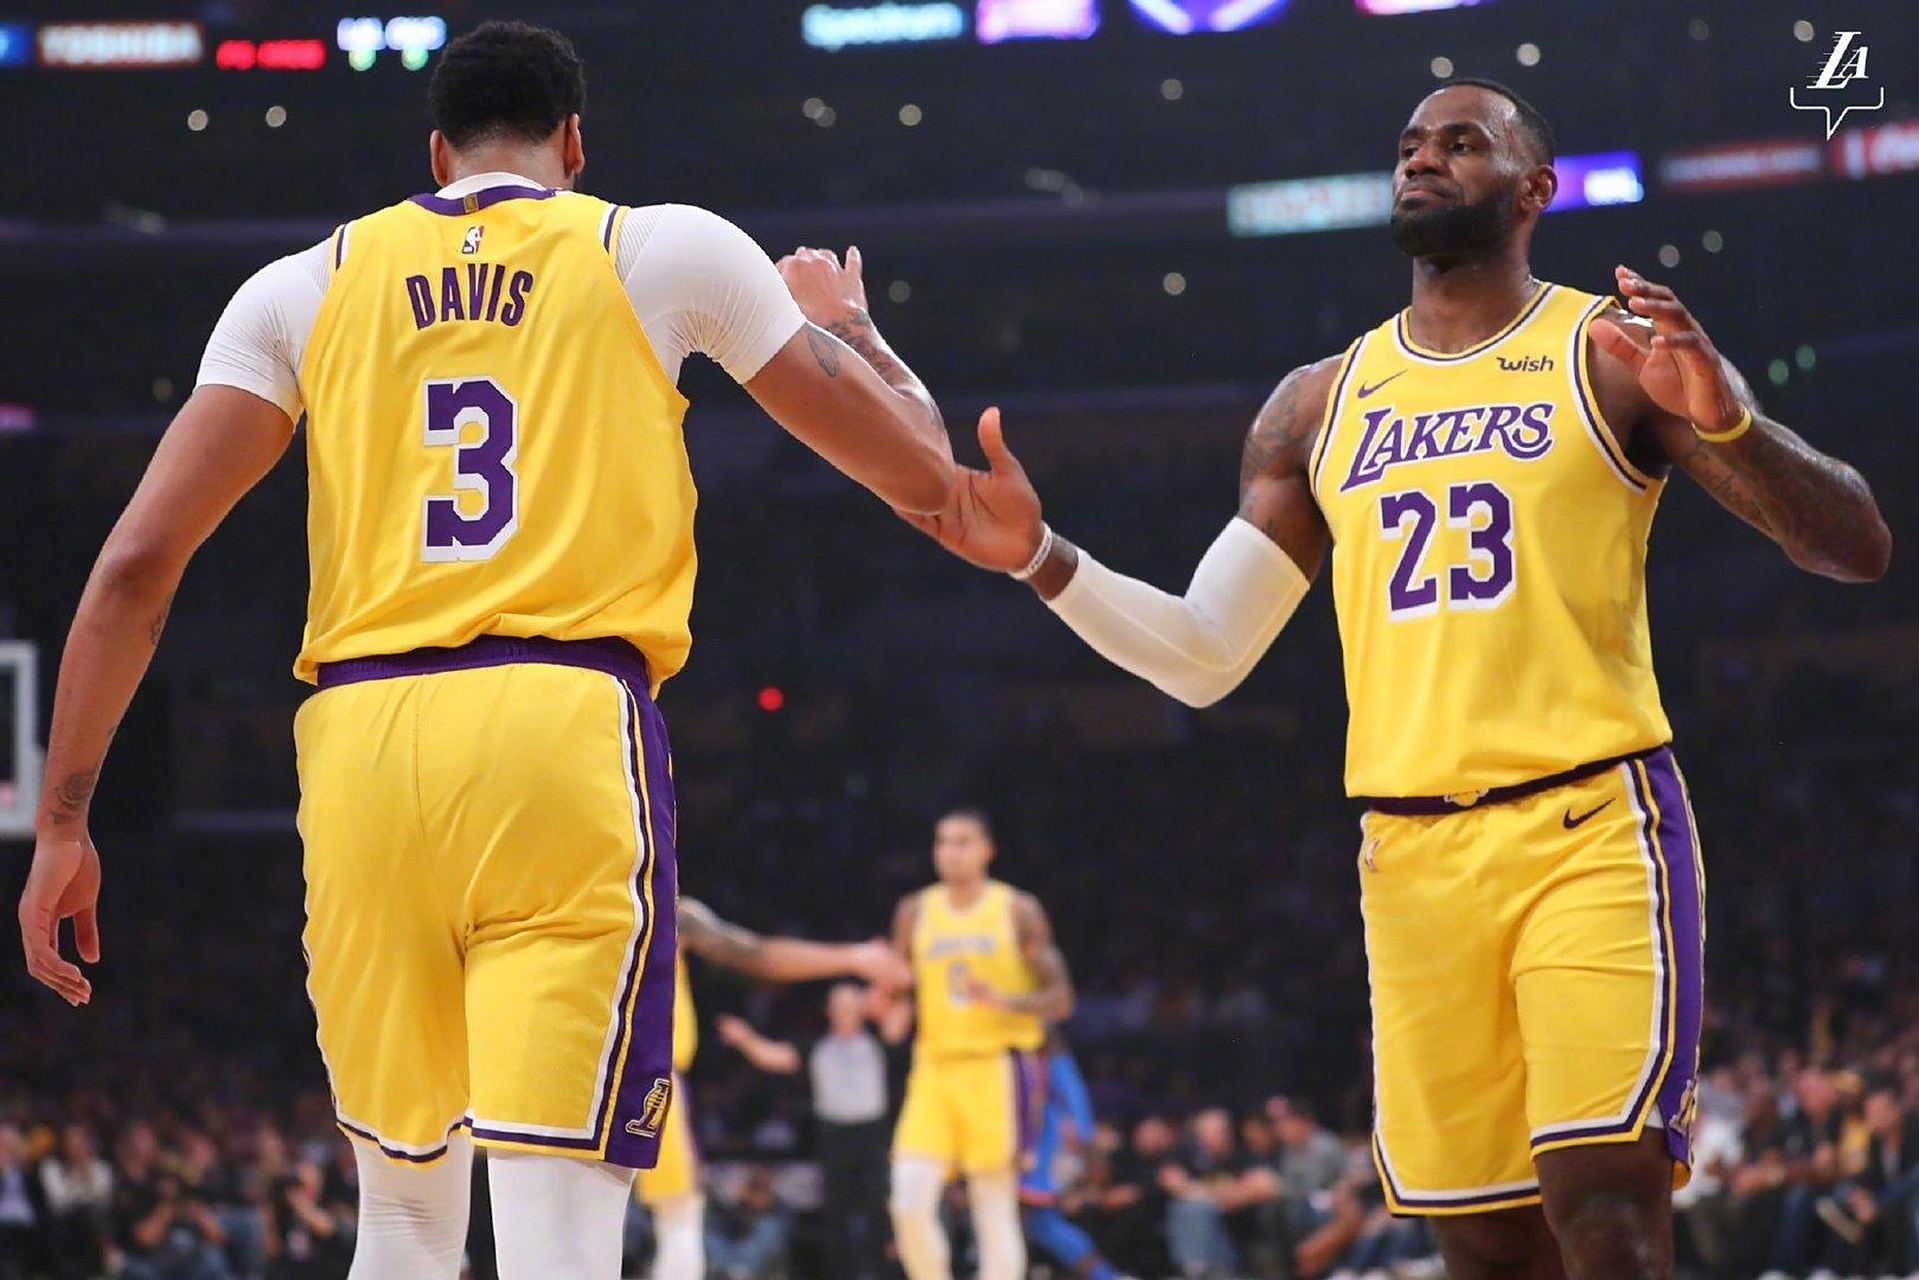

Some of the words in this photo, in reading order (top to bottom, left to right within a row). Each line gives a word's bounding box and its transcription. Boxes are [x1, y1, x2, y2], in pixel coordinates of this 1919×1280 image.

[405, 263, 534, 330] DAVIS
[1496, 355, 1554, 372] wish
[422, 376, 519, 562] 3
[1340, 402, 1554, 493] LAKERS
[1380, 482, 1517, 621] 23
